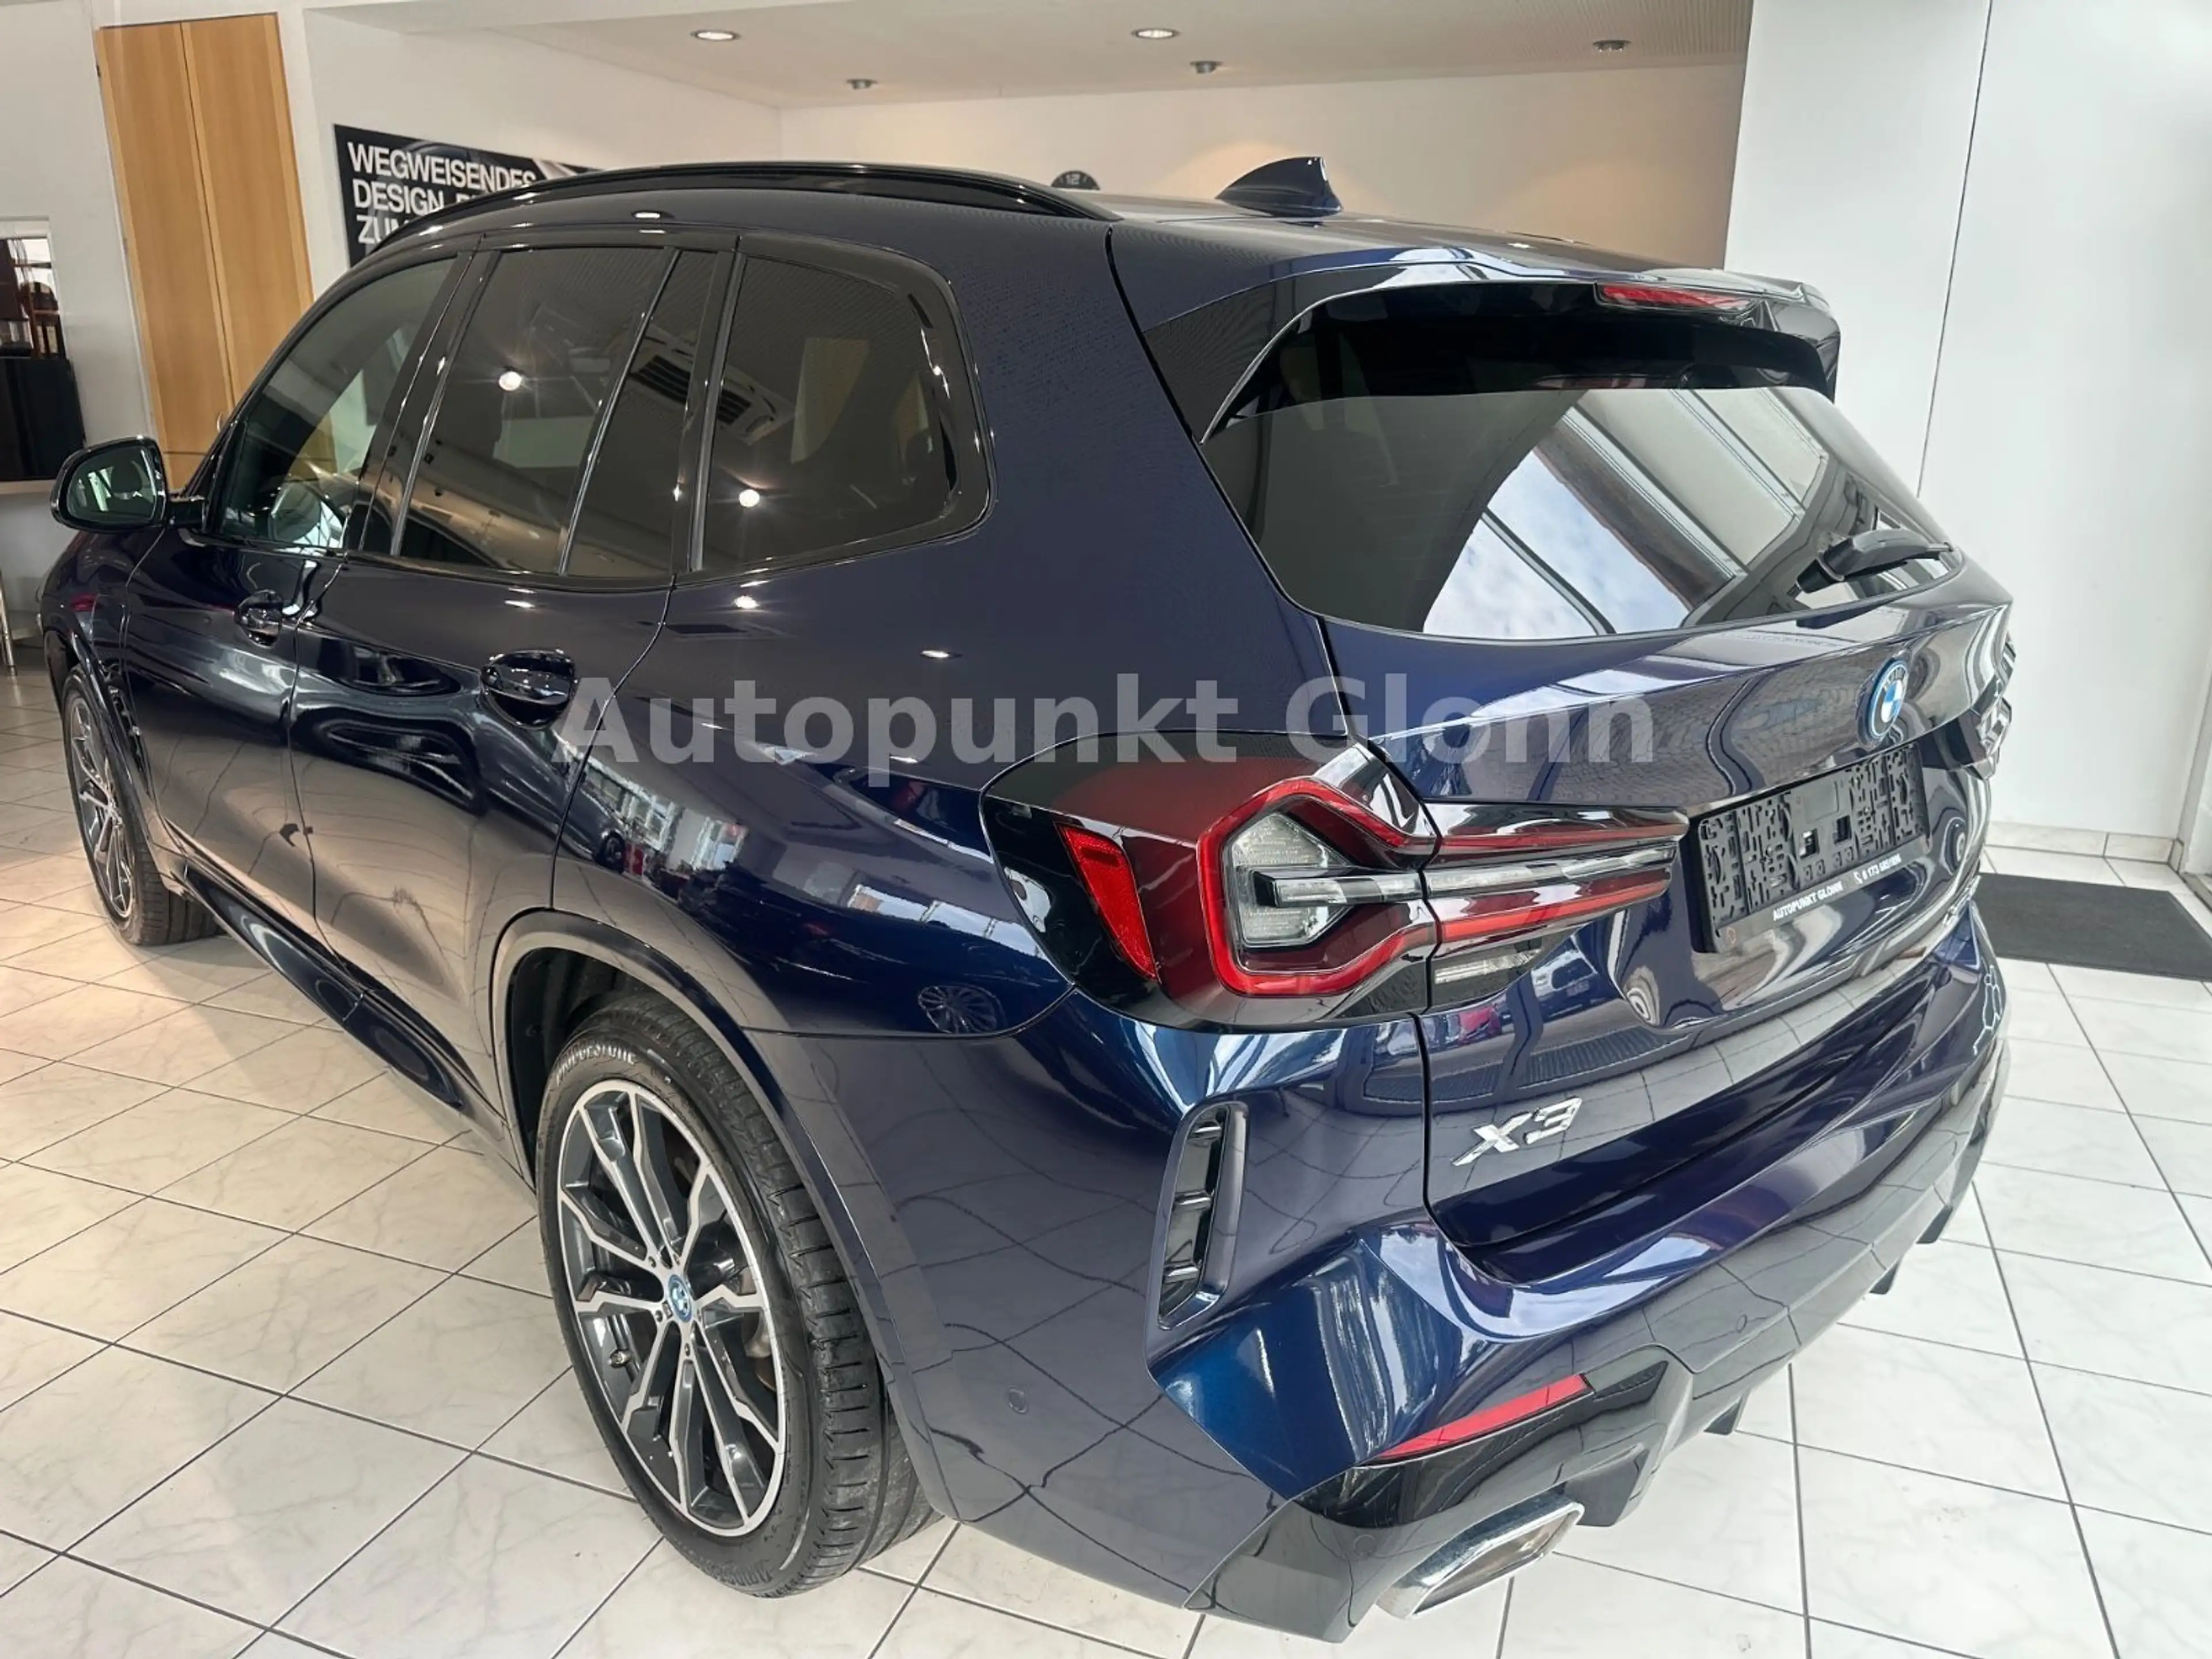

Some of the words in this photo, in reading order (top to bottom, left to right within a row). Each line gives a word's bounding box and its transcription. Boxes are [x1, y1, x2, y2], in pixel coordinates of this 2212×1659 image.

[347, 142, 537, 192] WEGWEISENDES
[353, 178, 444, 215] DESIGN
[1450, 1096, 1582, 1166] X3
